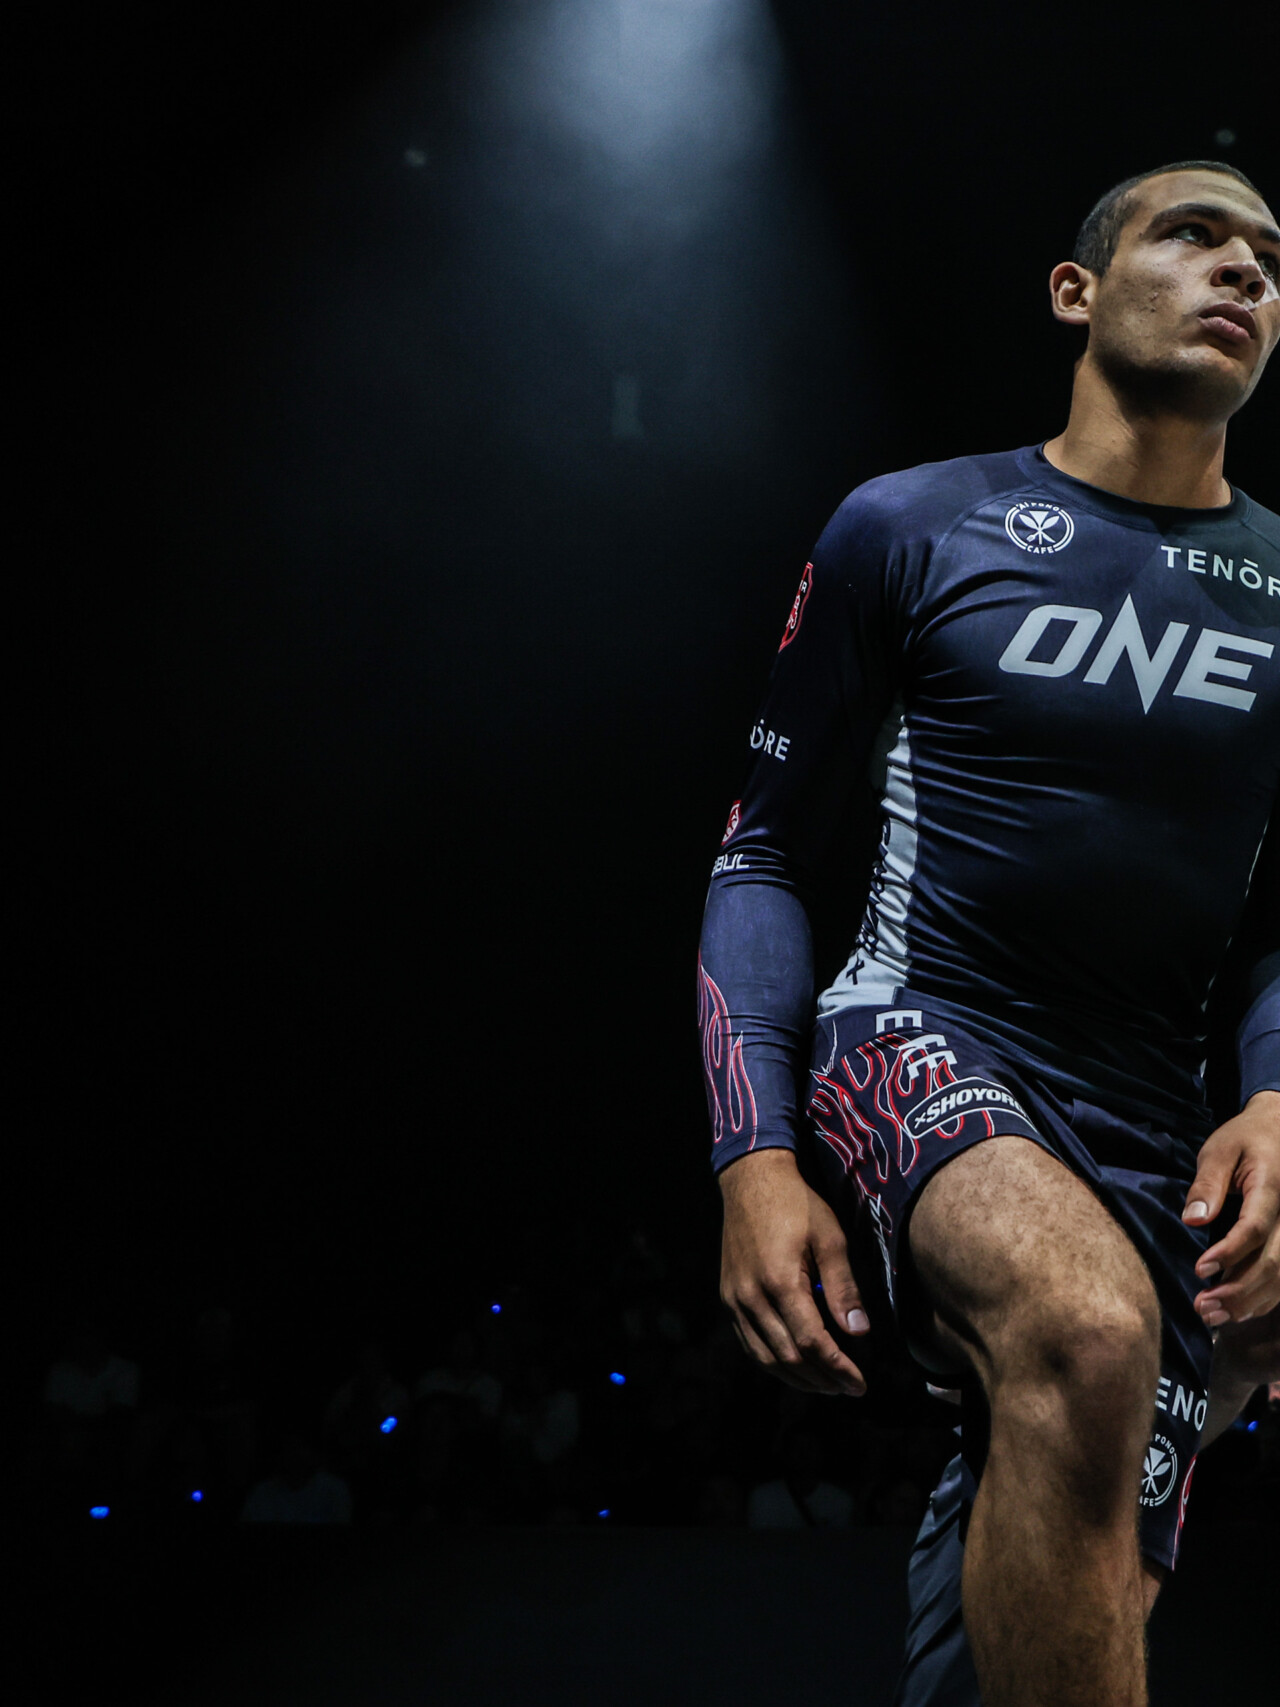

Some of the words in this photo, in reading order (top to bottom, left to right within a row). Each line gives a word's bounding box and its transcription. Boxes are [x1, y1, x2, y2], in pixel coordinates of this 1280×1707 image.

[1026, 545, 1055, 555] CAFE
[998, 592, 1275, 716] ONE
[711, 853, 750, 878] BUL
[1154, 1433, 1176, 1455] PONO
